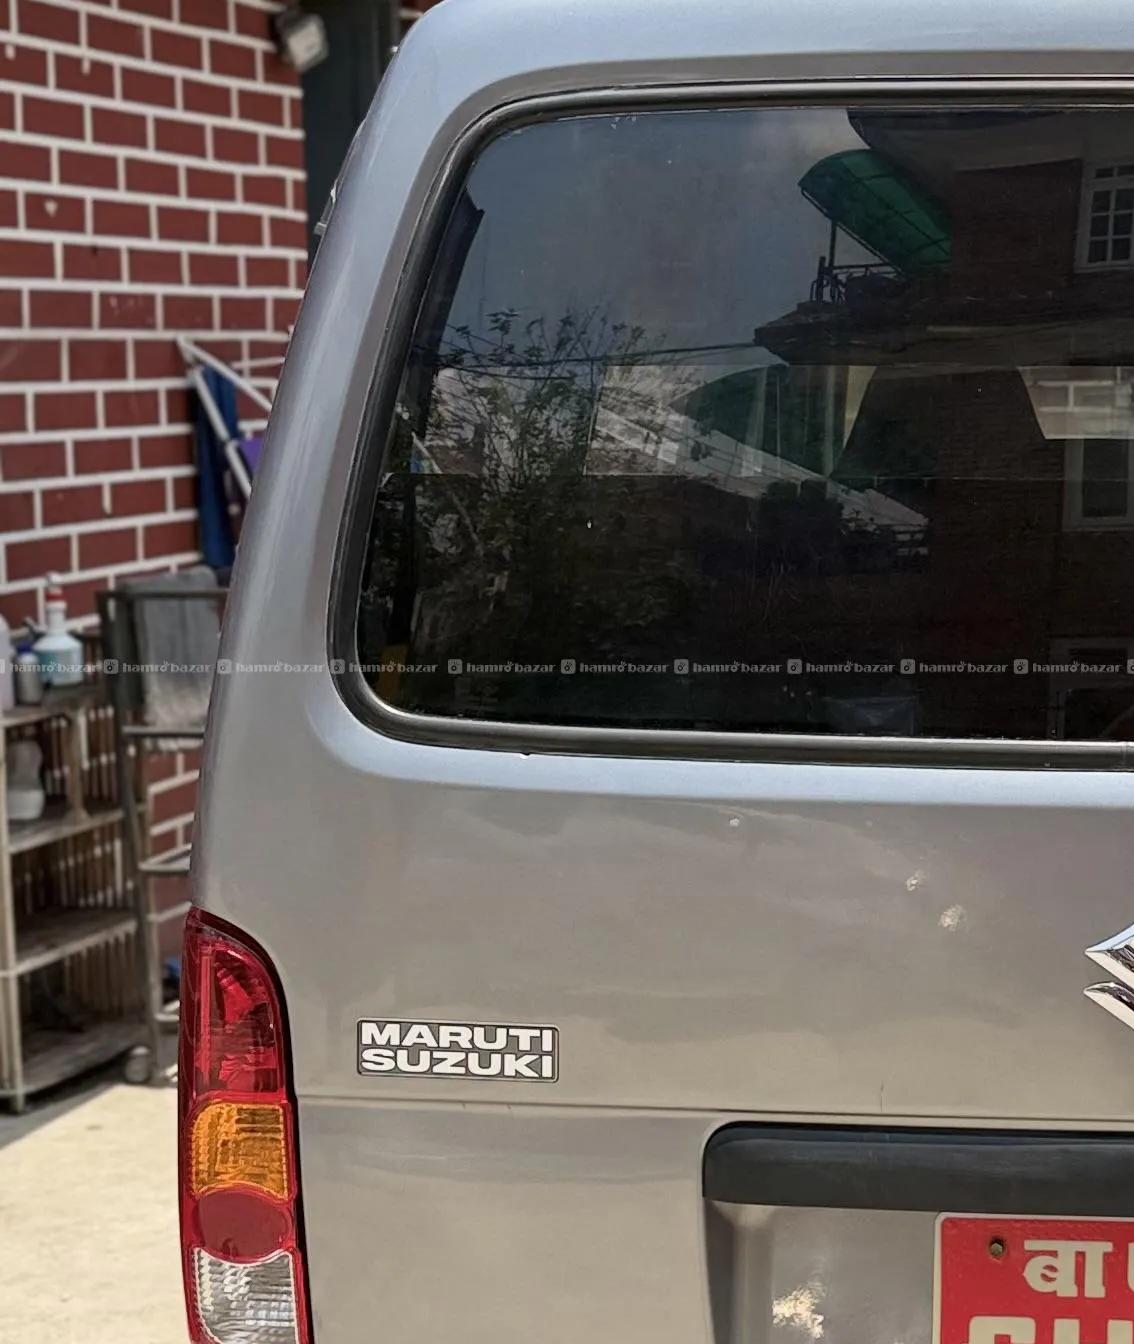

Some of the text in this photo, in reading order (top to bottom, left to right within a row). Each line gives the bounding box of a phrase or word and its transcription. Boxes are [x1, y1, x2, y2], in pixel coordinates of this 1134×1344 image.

[361, 1022, 553, 1052] MARUTI
[361, 1048, 553, 1078] SUZUKI
[1022, 1239, 1113, 1298] बा
